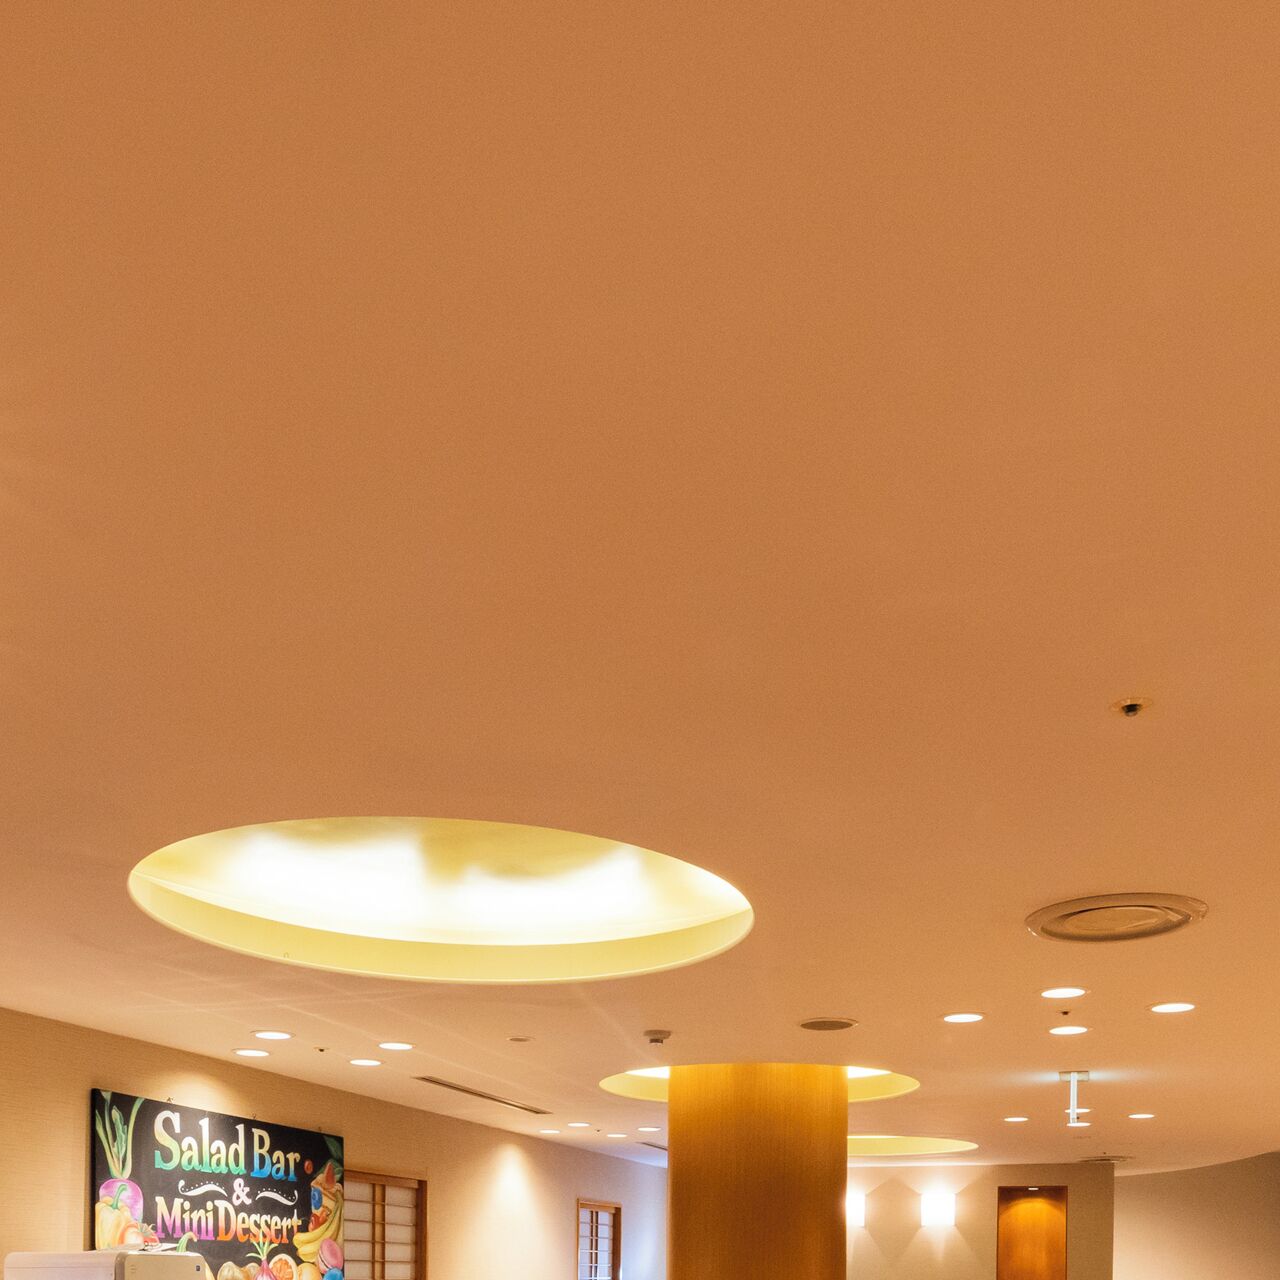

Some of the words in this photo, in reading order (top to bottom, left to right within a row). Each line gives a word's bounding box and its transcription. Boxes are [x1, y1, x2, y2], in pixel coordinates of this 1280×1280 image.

[153, 1109, 247, 1175] Salad
[250, 1127, 302, 1182] Bar
[231, 1177, 253, 1206] &
[153, 1196, 216, 1241] Mini
[214, 1199, 303, 1245] Dessert
